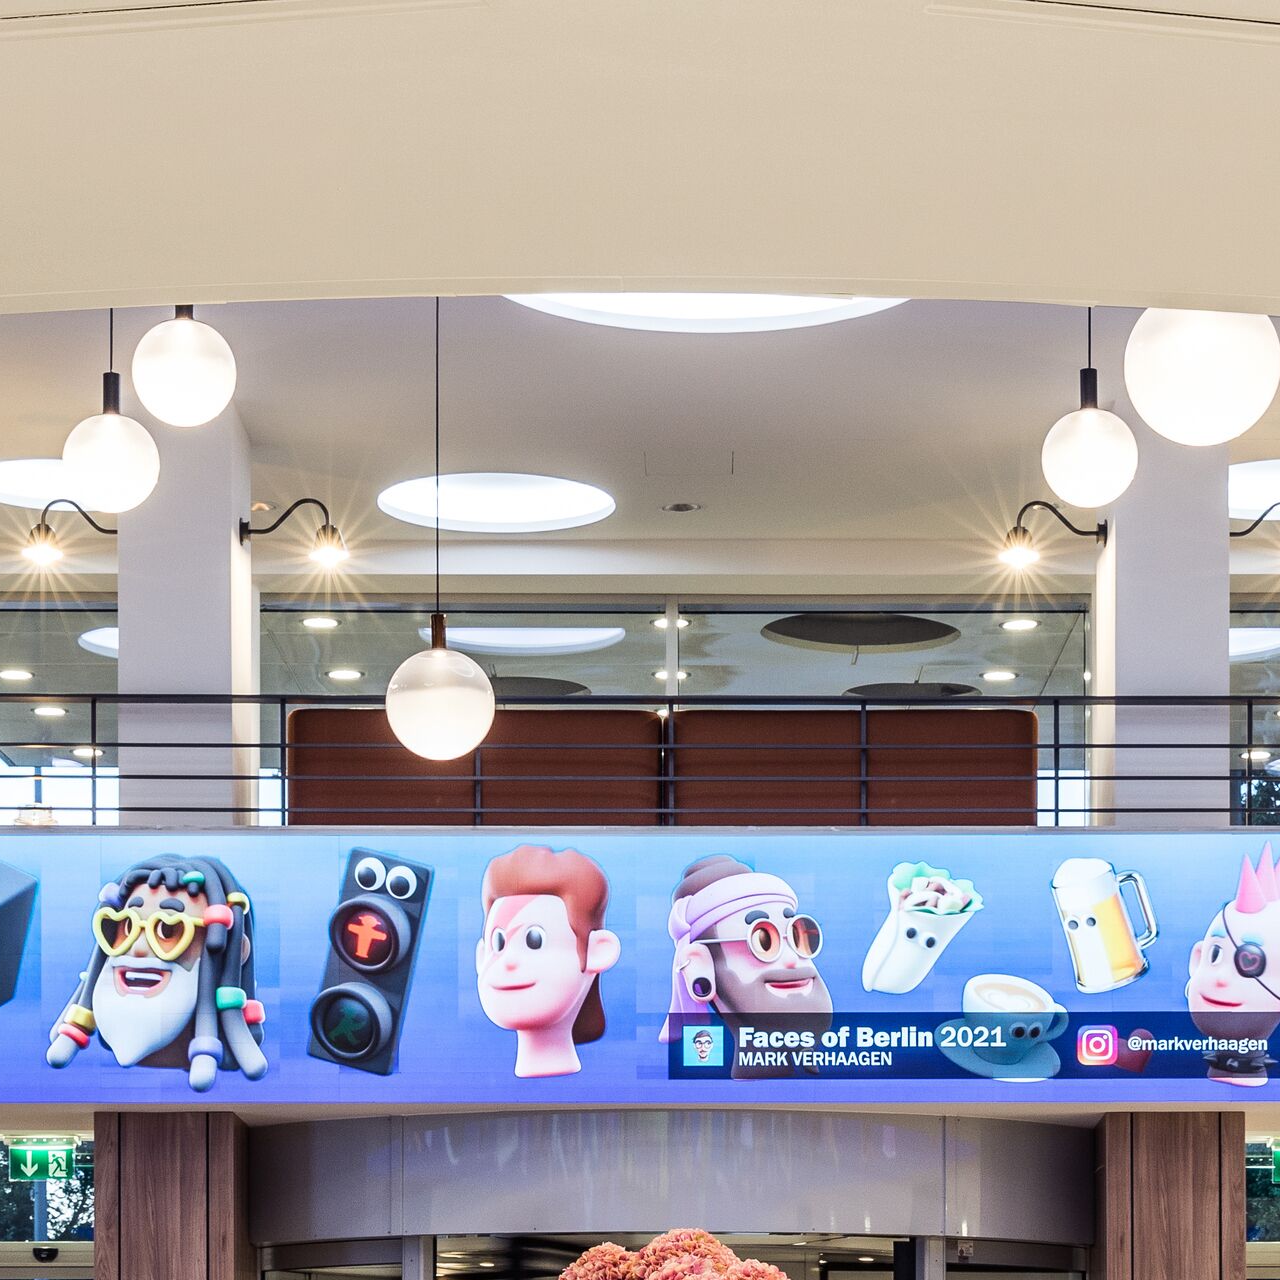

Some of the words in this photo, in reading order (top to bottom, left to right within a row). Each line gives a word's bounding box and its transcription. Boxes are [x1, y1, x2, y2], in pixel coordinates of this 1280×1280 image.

[738, 1026, 815, 1048] Faces
[821, 1026, 849, 1048] of
[856, 1026, 934, 1048] Berlin
[940, 1025, 1007, 1048] 2021
[1127, 1035, 1268, 1053] @markverhaagen
[738, 1051, 788, 1067] MARK
[792, 1051, 893, 1067] VERHAAGEN
